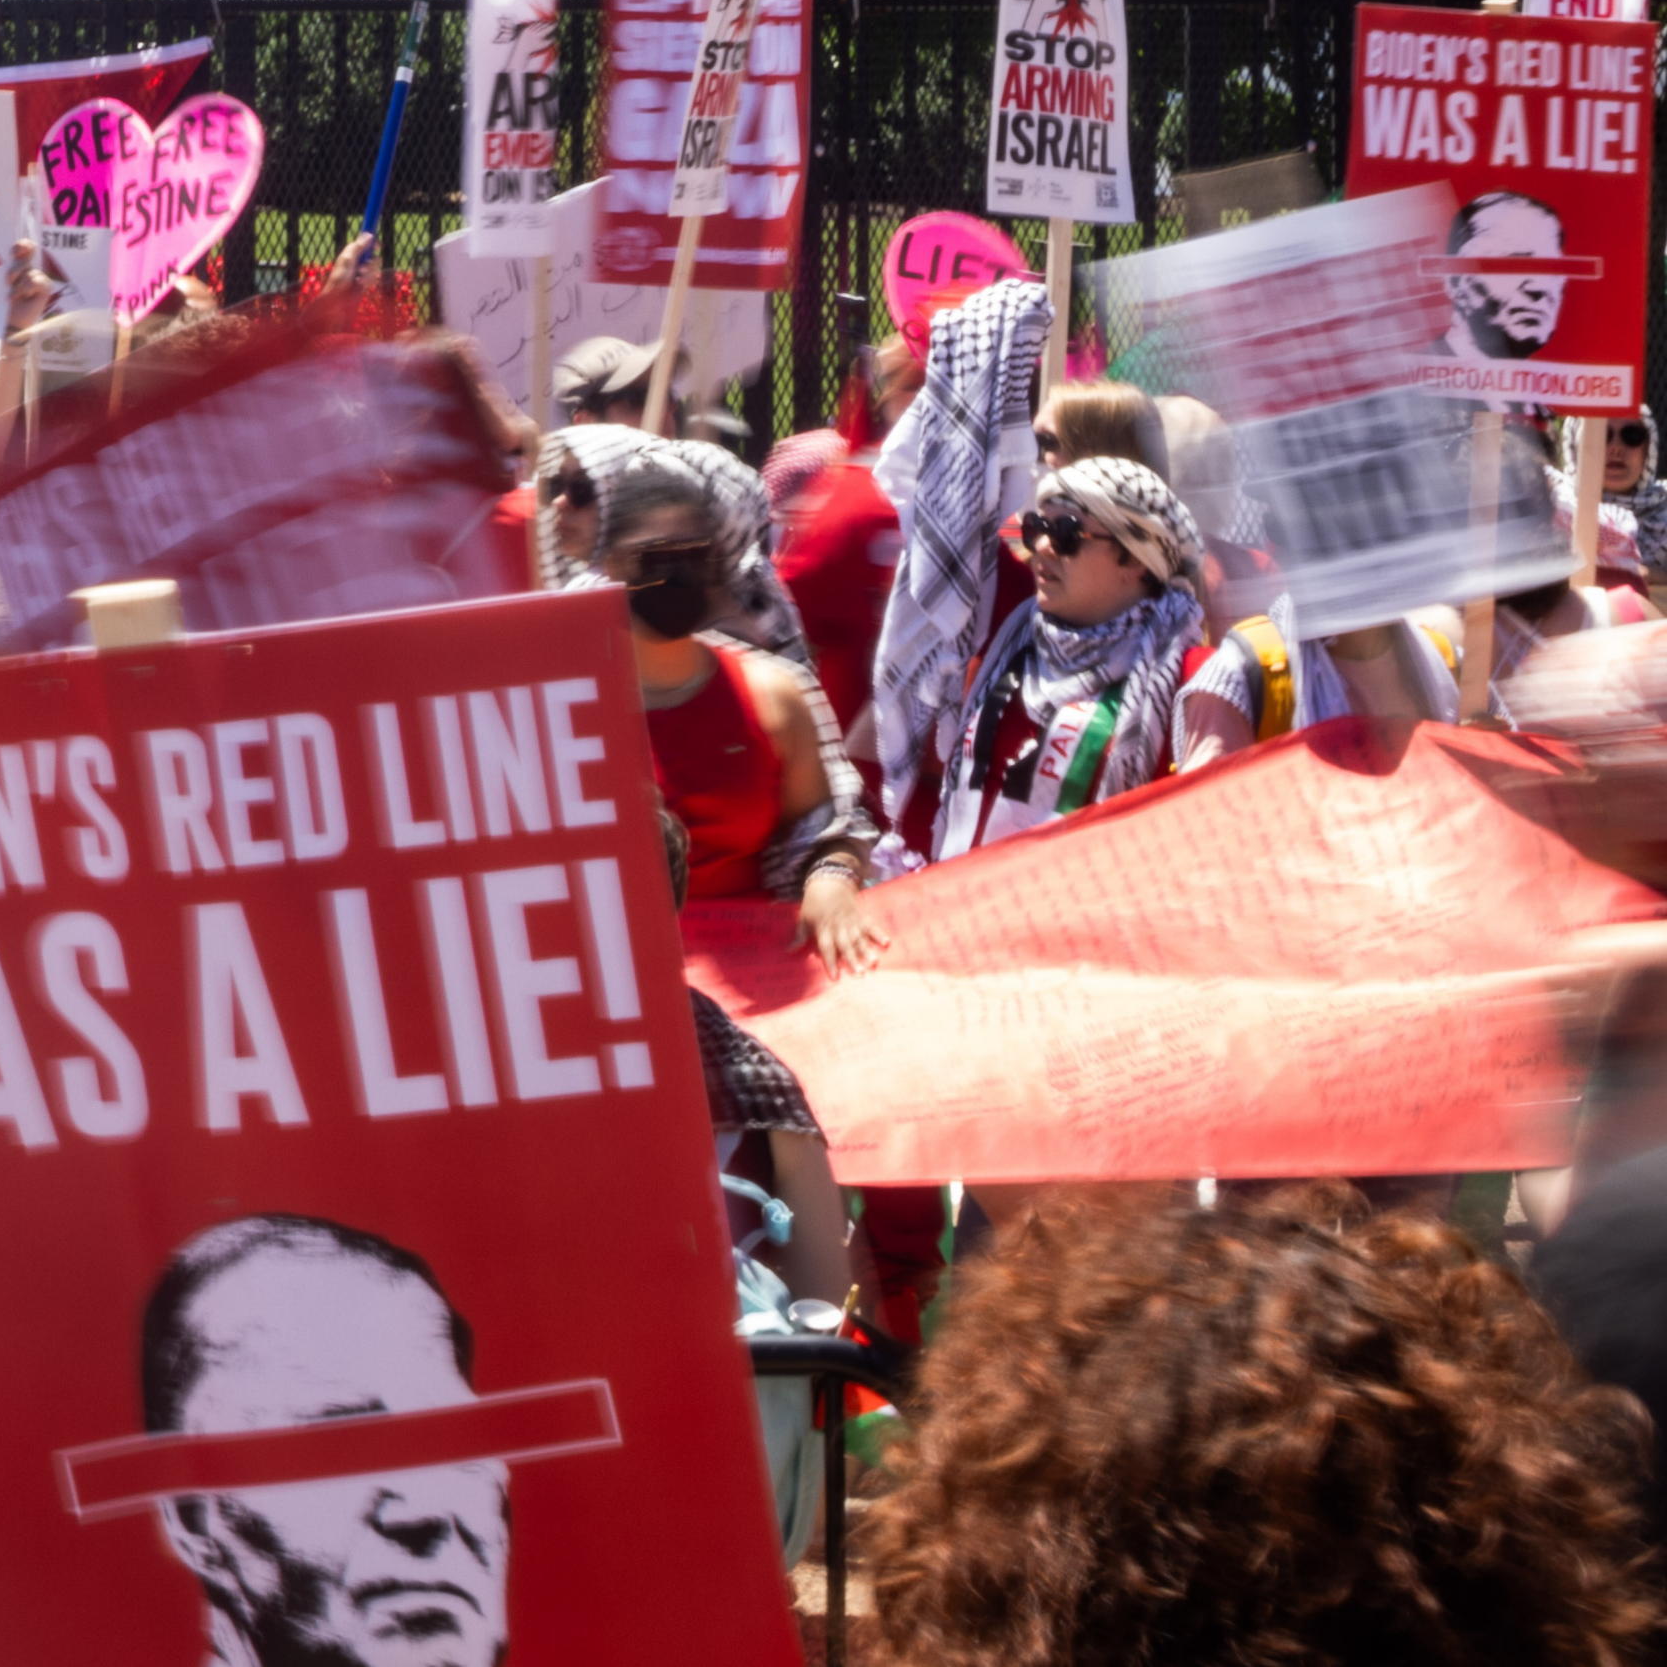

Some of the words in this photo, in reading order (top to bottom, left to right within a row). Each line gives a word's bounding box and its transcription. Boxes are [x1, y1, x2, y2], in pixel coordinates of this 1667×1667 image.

[1004, 30, 1115, 71] STOP
[1364, 30, 1489, 84] BIDEN'S
[1496, 39, 1561, 87] RED
[1569, 43, 1645, 93] LINE
[1000, 62, 1115, 122] ARMING
[1363, 85, 1478, 164] WAS
[1489, 94, 1530, 167] A
[1544, 96, 1640, 173] LIE!
[41, 111, 136, 188] FREE
[151, 105, 245, 182] FREE
[996, 110, 1117, 175] ISRAEL
[137, 709, 352, 876] RED
[360, 674, 620, 854] LINE
[182, 897, 312, 1134] A
[319, 854, 658, 1123] LIE!
